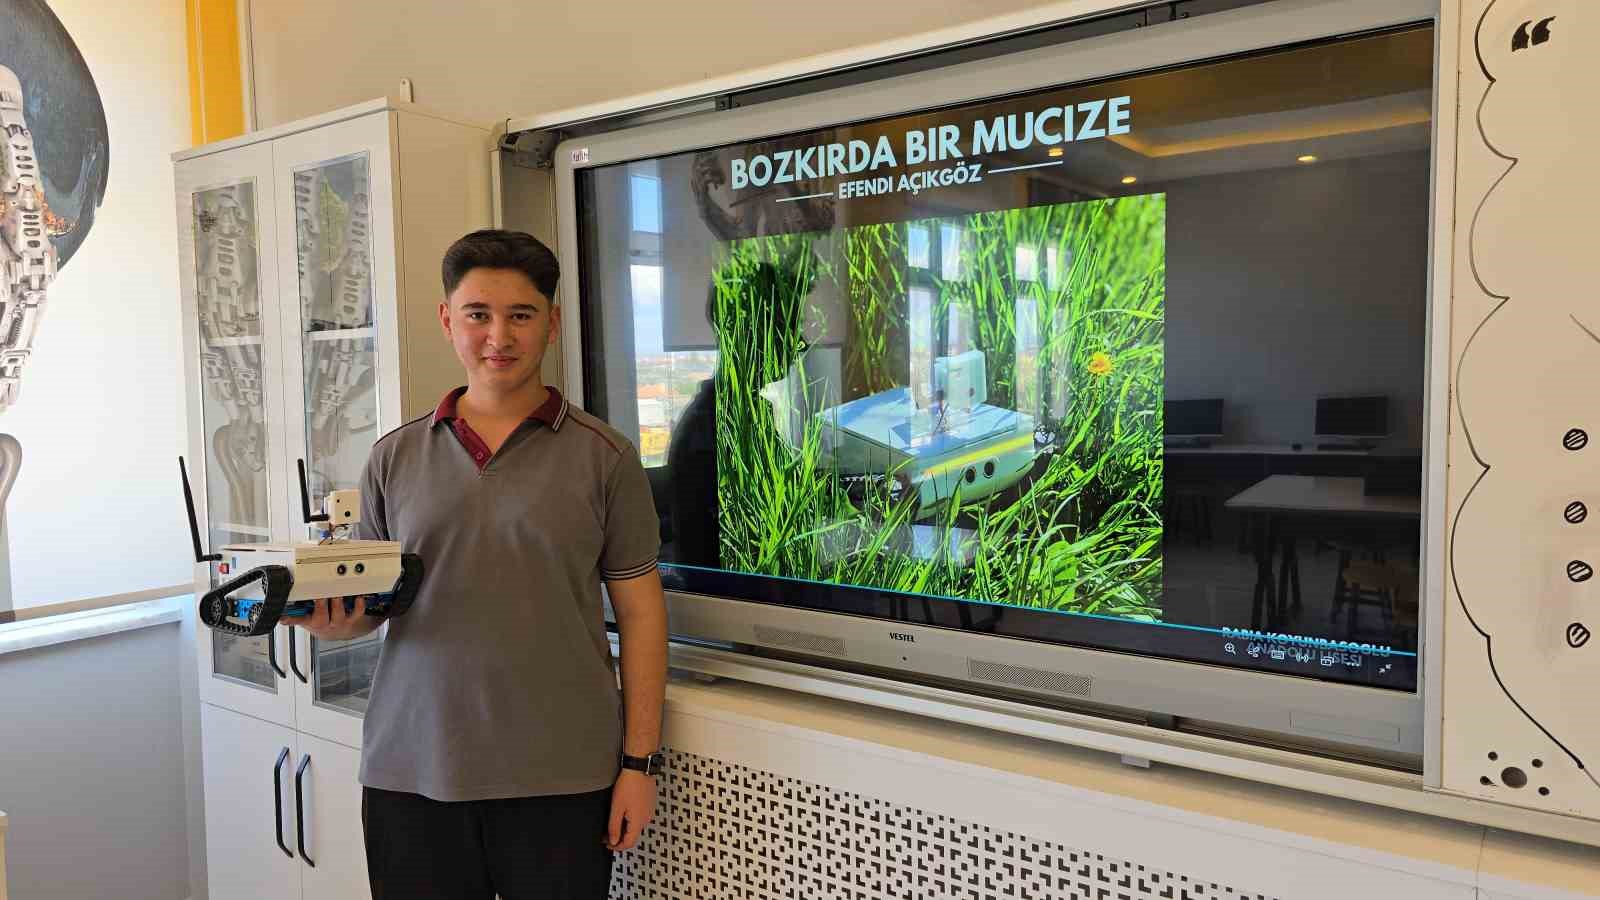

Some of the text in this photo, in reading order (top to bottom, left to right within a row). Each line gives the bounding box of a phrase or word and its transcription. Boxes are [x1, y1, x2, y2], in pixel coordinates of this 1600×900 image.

[731, 96, 1132, 190] BOZKIRDA BIR MUCIZE
[838, 162, 983, 201] EFENDI AÇIKGÖZ
[889, 632, 915, 642] VESTEL
